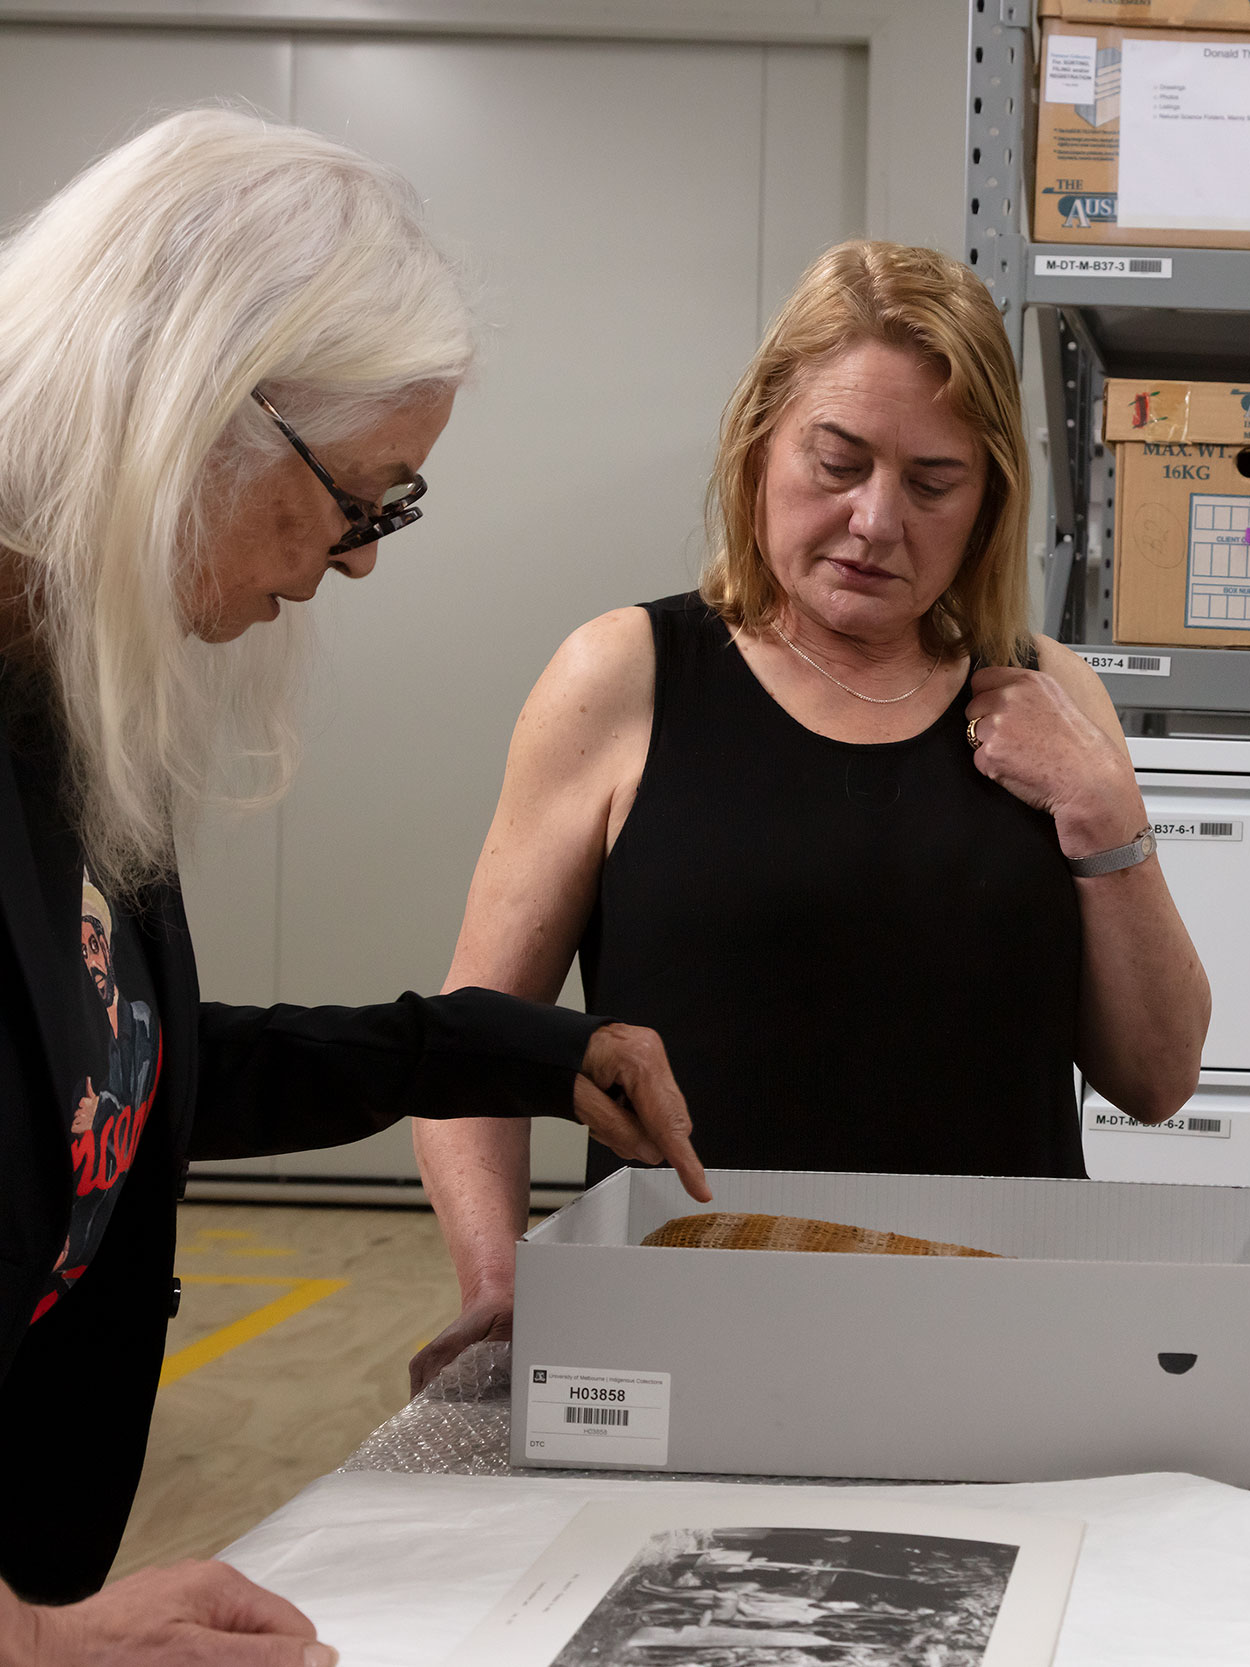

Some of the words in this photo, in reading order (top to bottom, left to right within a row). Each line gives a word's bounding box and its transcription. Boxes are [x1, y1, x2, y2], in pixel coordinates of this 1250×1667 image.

[1203, 48, 1239, 59] Donald
[1056, 179, 1084, 190] THE
[1061, 198, 1118, 228] AUS
[1046, 260, 1125, 271] M-DT-M-B37-3
[1143, 443, 1192, 457] MAX.
[1199, 443, 1232, 458] WT.
[1162, 464, 1210, 481] 16KG
[570, 1386, 626, 1402] H03858
